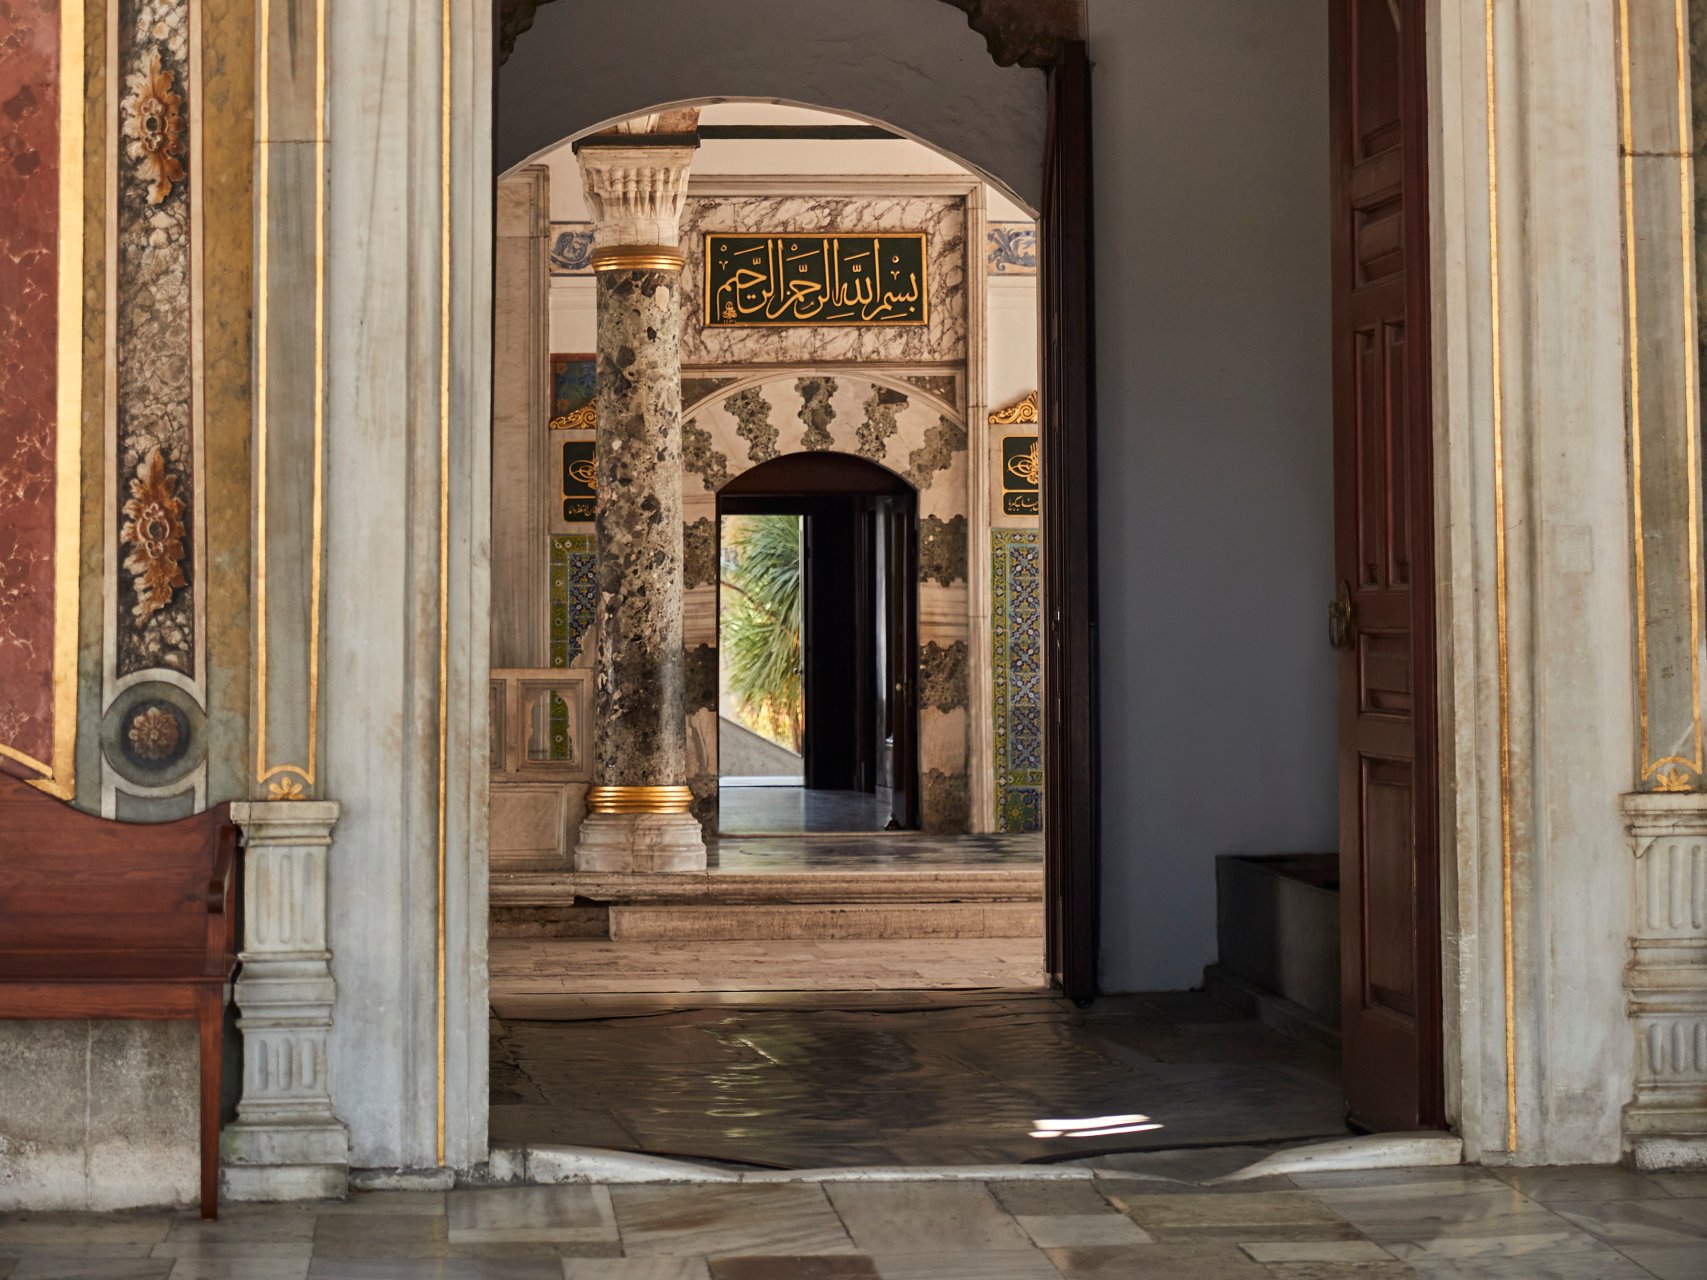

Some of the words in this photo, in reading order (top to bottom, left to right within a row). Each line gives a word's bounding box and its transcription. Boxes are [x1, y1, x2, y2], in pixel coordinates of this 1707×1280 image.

[717, 239, 784, 321] الرحيم
[833, 239, 881, 308] الله
[862, 268, 919, 322] بسم
